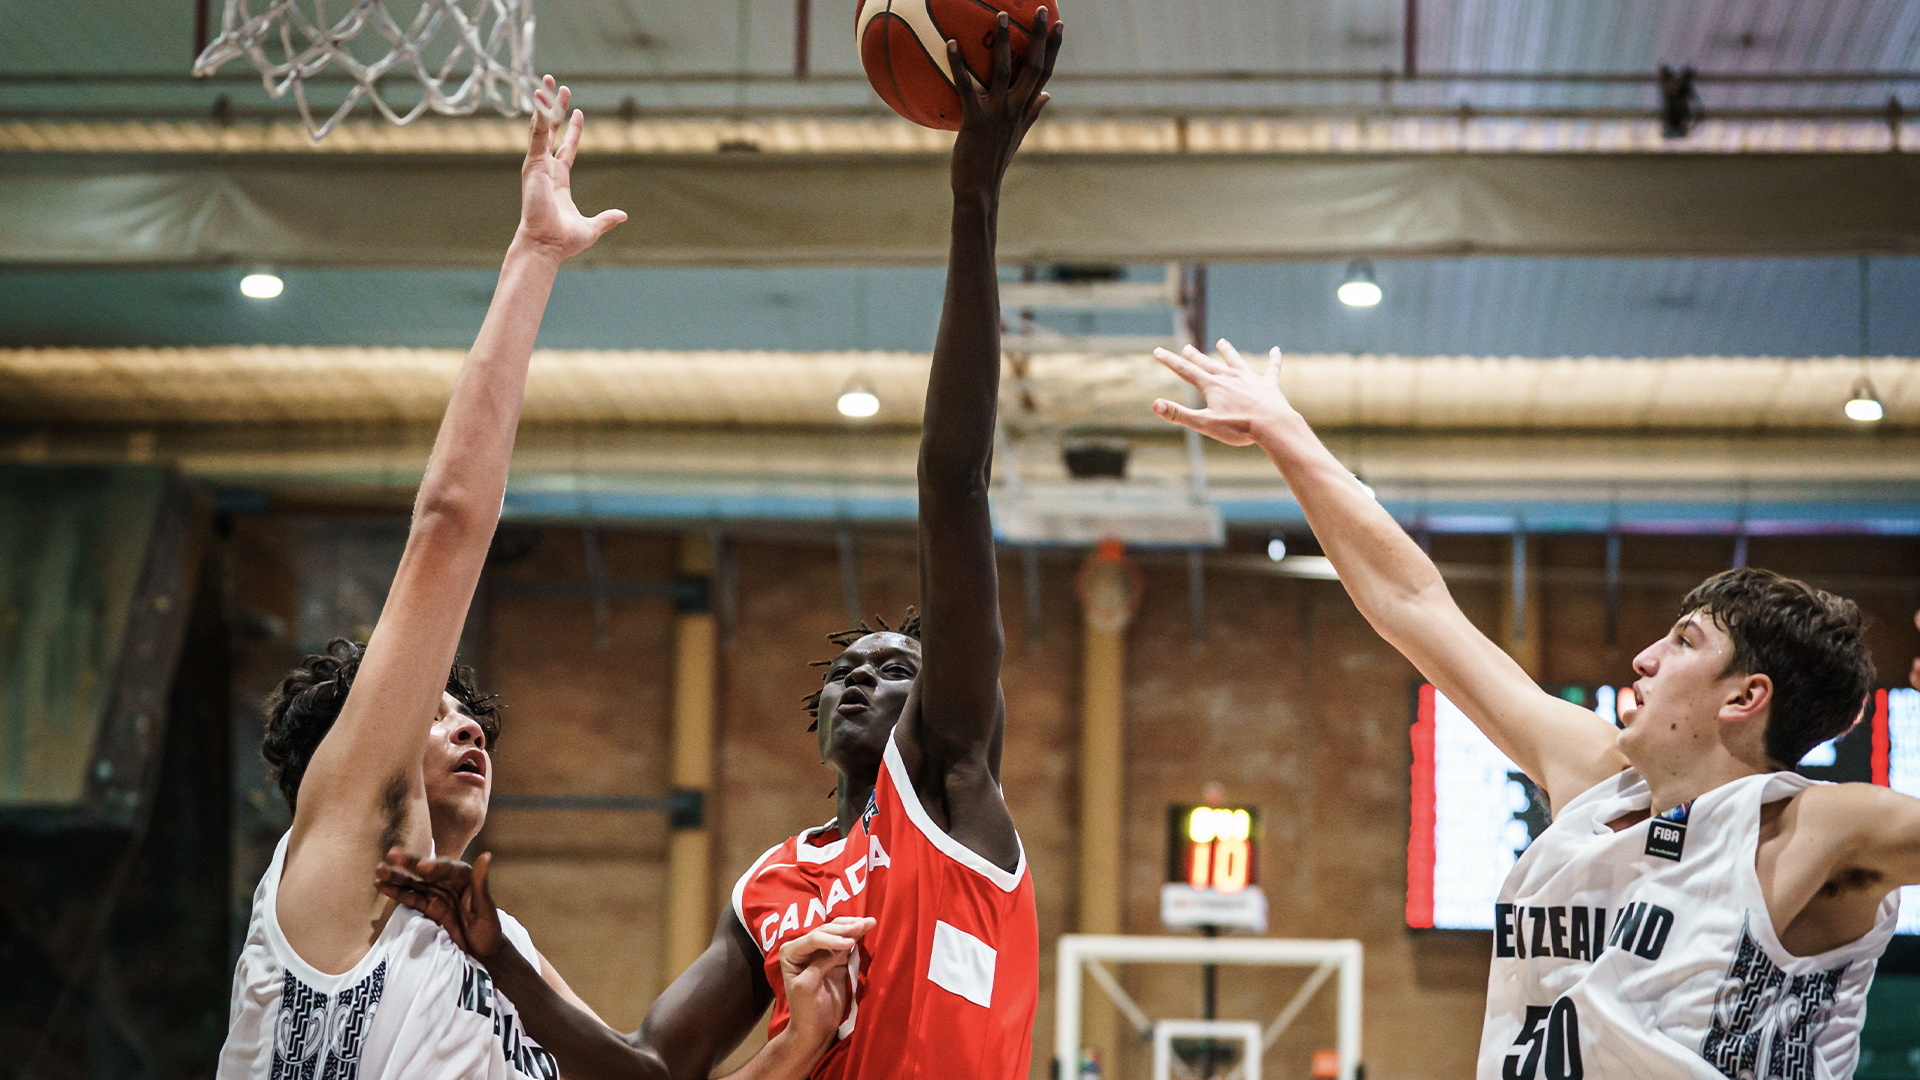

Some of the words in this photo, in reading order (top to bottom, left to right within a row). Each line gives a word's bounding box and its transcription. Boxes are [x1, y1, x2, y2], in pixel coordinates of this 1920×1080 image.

[1653, 825, 1680, 843] FIBA
[761, 834, 890, 952] CANADA
[1189, 838, 1250, 894] 10
[1529, 901, 1674, 963] ZEALND
[457, 961, 493, 1018] NE
[1502, 996, 1584, 1080] 50
